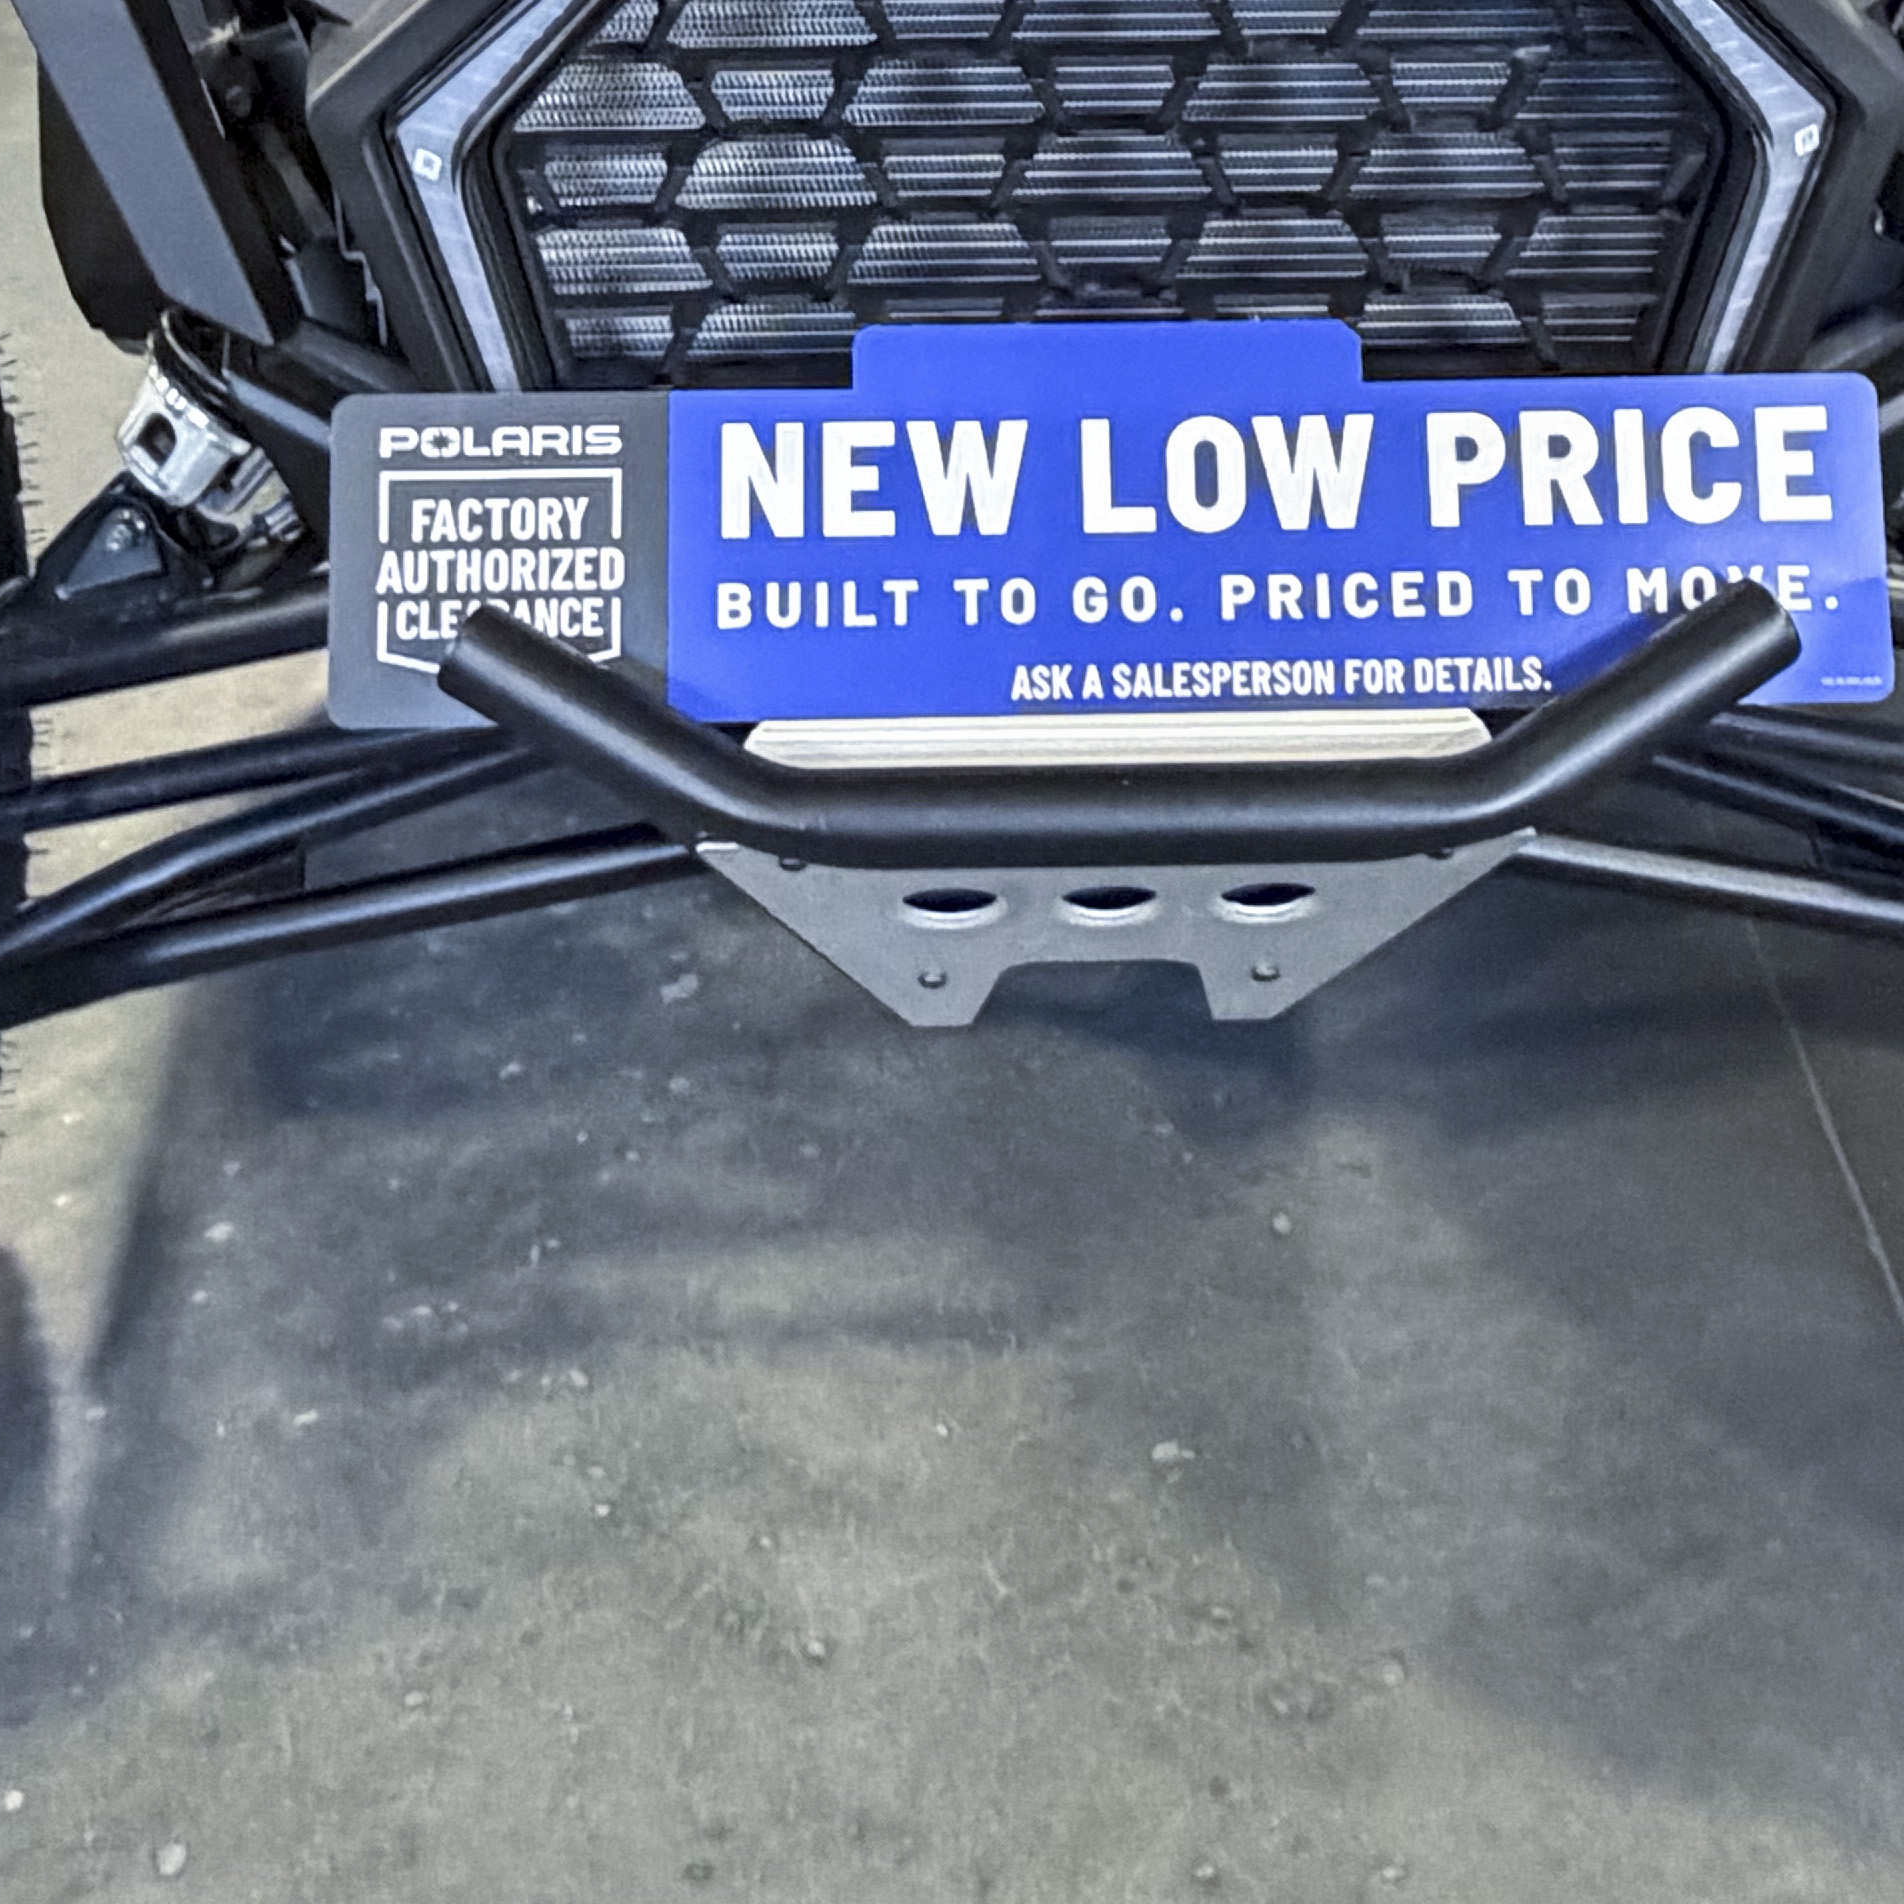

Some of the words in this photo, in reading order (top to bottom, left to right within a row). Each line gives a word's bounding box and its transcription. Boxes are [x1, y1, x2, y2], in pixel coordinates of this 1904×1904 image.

[379, 424, 624, 459] POLARIS
[719, 419, 1028, 540] NEW
[1081, 413, 1374, 534] LOW
[1427, 404, 1834, 528] PRICE
[411, 496, 590, 543] FACTORY
[375, 546, 626, 595] AUTHORIZED
[717, 579, 919, 630] BUILT
[954, 578, 1036, 626] TO
[1072, 575, 1184, 624] GO.
[1221, 570, 1473, 621] PRICED
[1508, 567, 1591, 616] TO
[1011, 664, 1074, 701] ASK
[1081, 665, 1105, 700] A
[1111, 659, 1336, 699] SALESPERSON
[1344, 658, 1406, 695] FOR
[1414, 655, 1552, 694] DETAILS.
